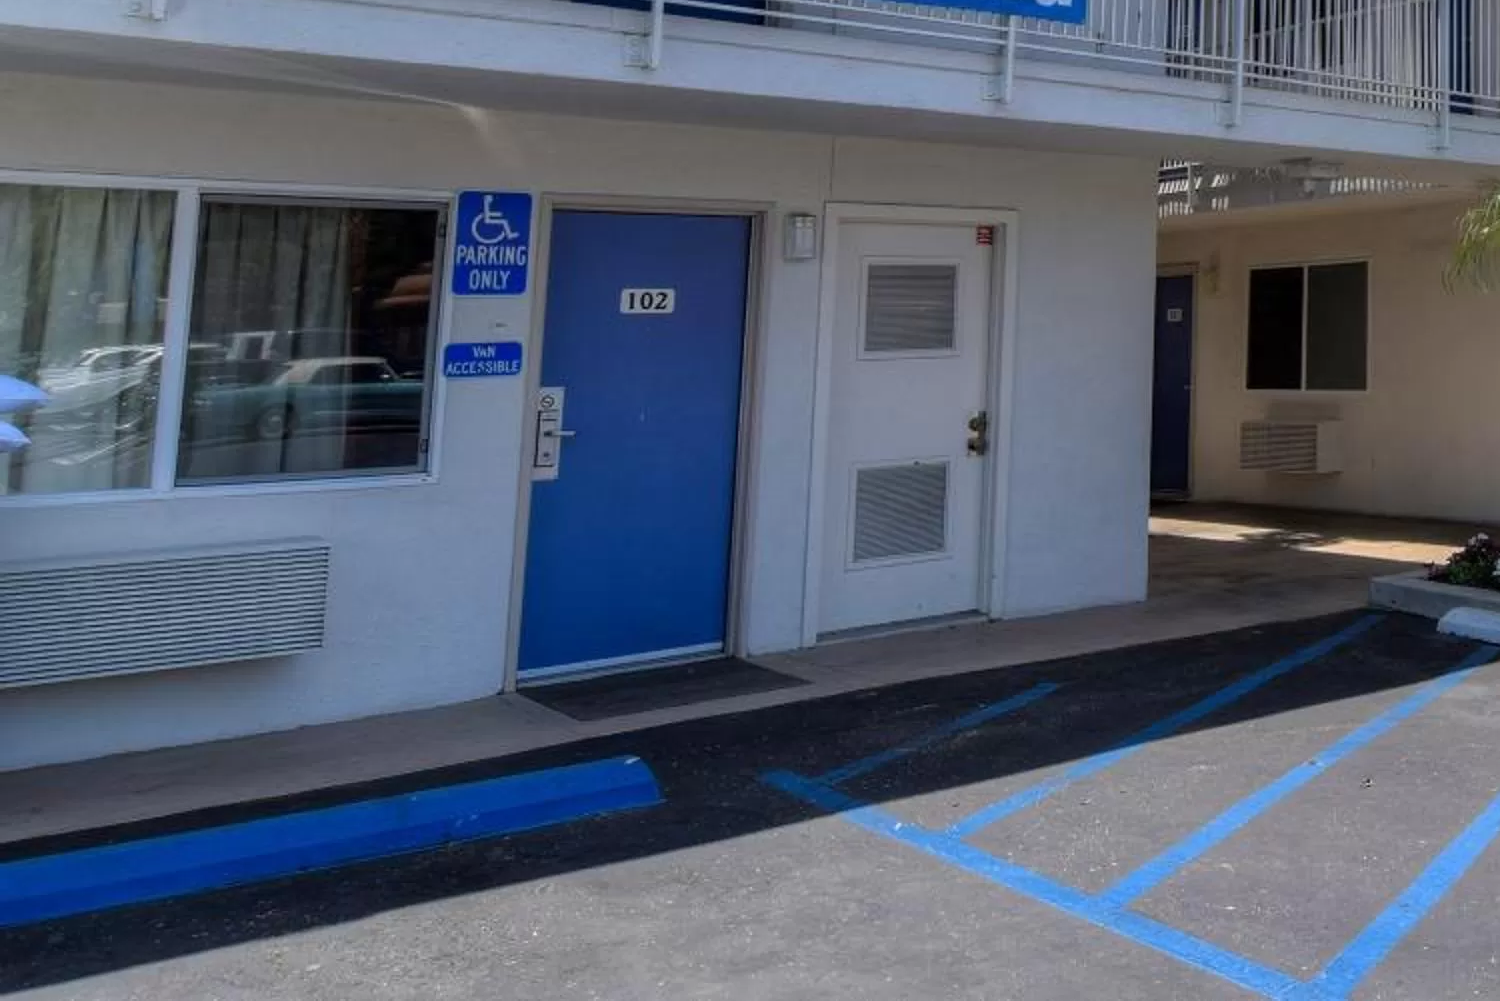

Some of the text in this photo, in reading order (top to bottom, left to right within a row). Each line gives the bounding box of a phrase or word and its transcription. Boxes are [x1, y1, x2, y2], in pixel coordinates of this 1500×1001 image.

[456, 244, 527, 266] PARKING
[469, 269, 511, 290] ONLY
[629, 292, 668, 310] 102
[472, 345, 497, 358] VAN
[446, 359, 521, 375] ACCESSIBLE
